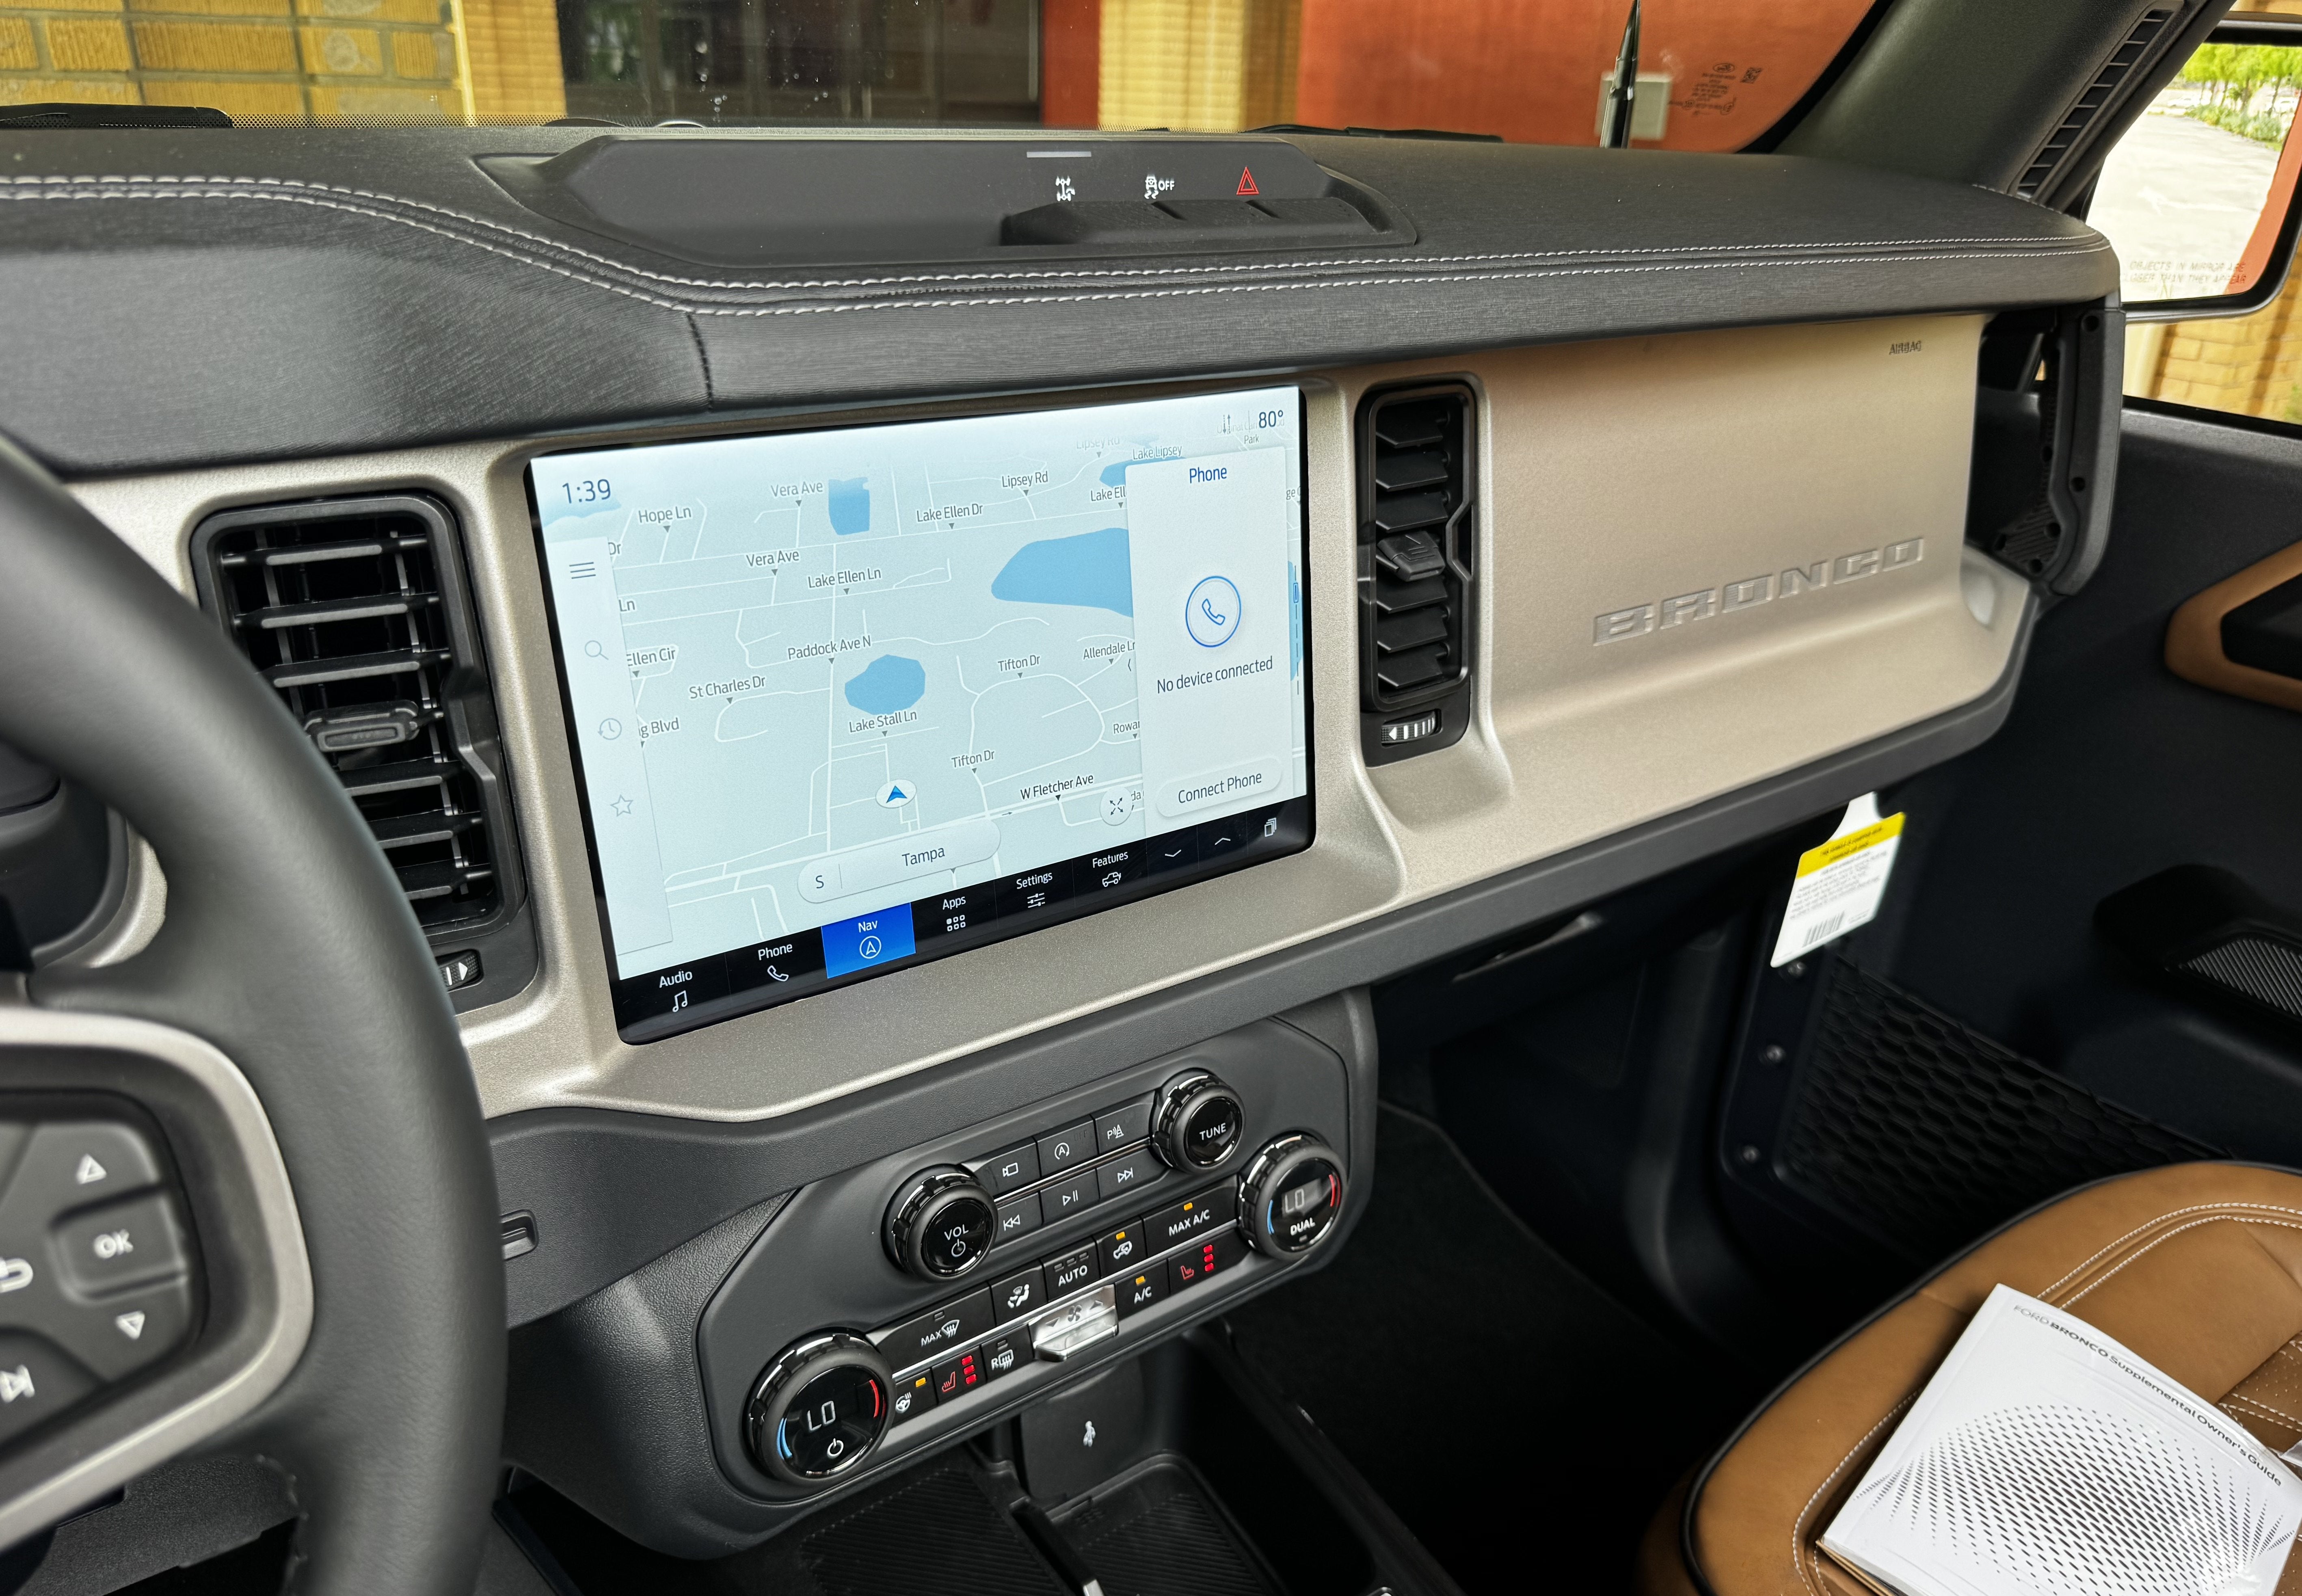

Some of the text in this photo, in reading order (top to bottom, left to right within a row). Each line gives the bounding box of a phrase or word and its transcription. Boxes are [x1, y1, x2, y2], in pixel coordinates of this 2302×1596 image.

[1158, 179, 1175, 192] OFF
[1889, 340, 1922, 355] AIRBAG
[1244, 434, 1259, 444] Park
[1133, 445, 1182, 460] Lake Lipsey
[1001, 471, 1049, 489] Lipsey Rd
[1189, 465, 1227, 484] Phone
[562, 478, 612, 504] 1:39
[770, 481, 823, 498] Vera Ave
[1090, 489, 1112, 502] Lake
[638, 506, 692, 524] Hope Ln
[916, 502, 983, 522] Lake Ellen Dr
[746, 550, 800, 567] Vera Ave
[808, 567, 882, 588] Lake Ellen Ln
[1593, 537, 1924, 646] BRONCO
[618, 599, 635, 612] Ln
[659, 648, 675, 661] Cir
[787, 635, 872, 660] Paddock Ave N
[1083, 642, 1125, 660] Allendale
[998, 653, 1040, 672] Tifton Dr
[1157, 656, 1273, 694] No device connected
[690, 675, 765, 700] St Charles Dr
[639, 717, 679, 738] g Blvd
[849, 710, 917, 733] Lake Stall Ln
[951, 750, 995, 769] Tifton Dr
[1020, 773, 1094, 800] W Fletcher Ave
[1178, 772, 1262, 804] Connect Phone
[901, 846, 945, 867] Tampa
[1092, 850, 1129, 868] Features
[815, 875, 824, 889] S
[1016, 871, 1053, 890] Settings
[942, 895, 966, 911] Apps
[858, 919, 878, 933] Nav
[758, 942, 793, 961] Phone
[659, 969, 693, 988] Audio
[1199, 1122, 1227, 1141] TUNE
[944, 1224, 969, 1241] VOL
[1169, 1210, 1210, 1237] MAX A/C
[1290, 1217, 1316, 1236] DUAL
[93, 1228, 134, 1259] OK
[1058, 1264, 1088, 1286] AUTO
[1134, 1285, 1152, 1304] A/C
[921, 1330, 942, 1347] MAX
[2014, 1304, 2282, 1487] FORD BRONCO Supplemental Owner's Guide
